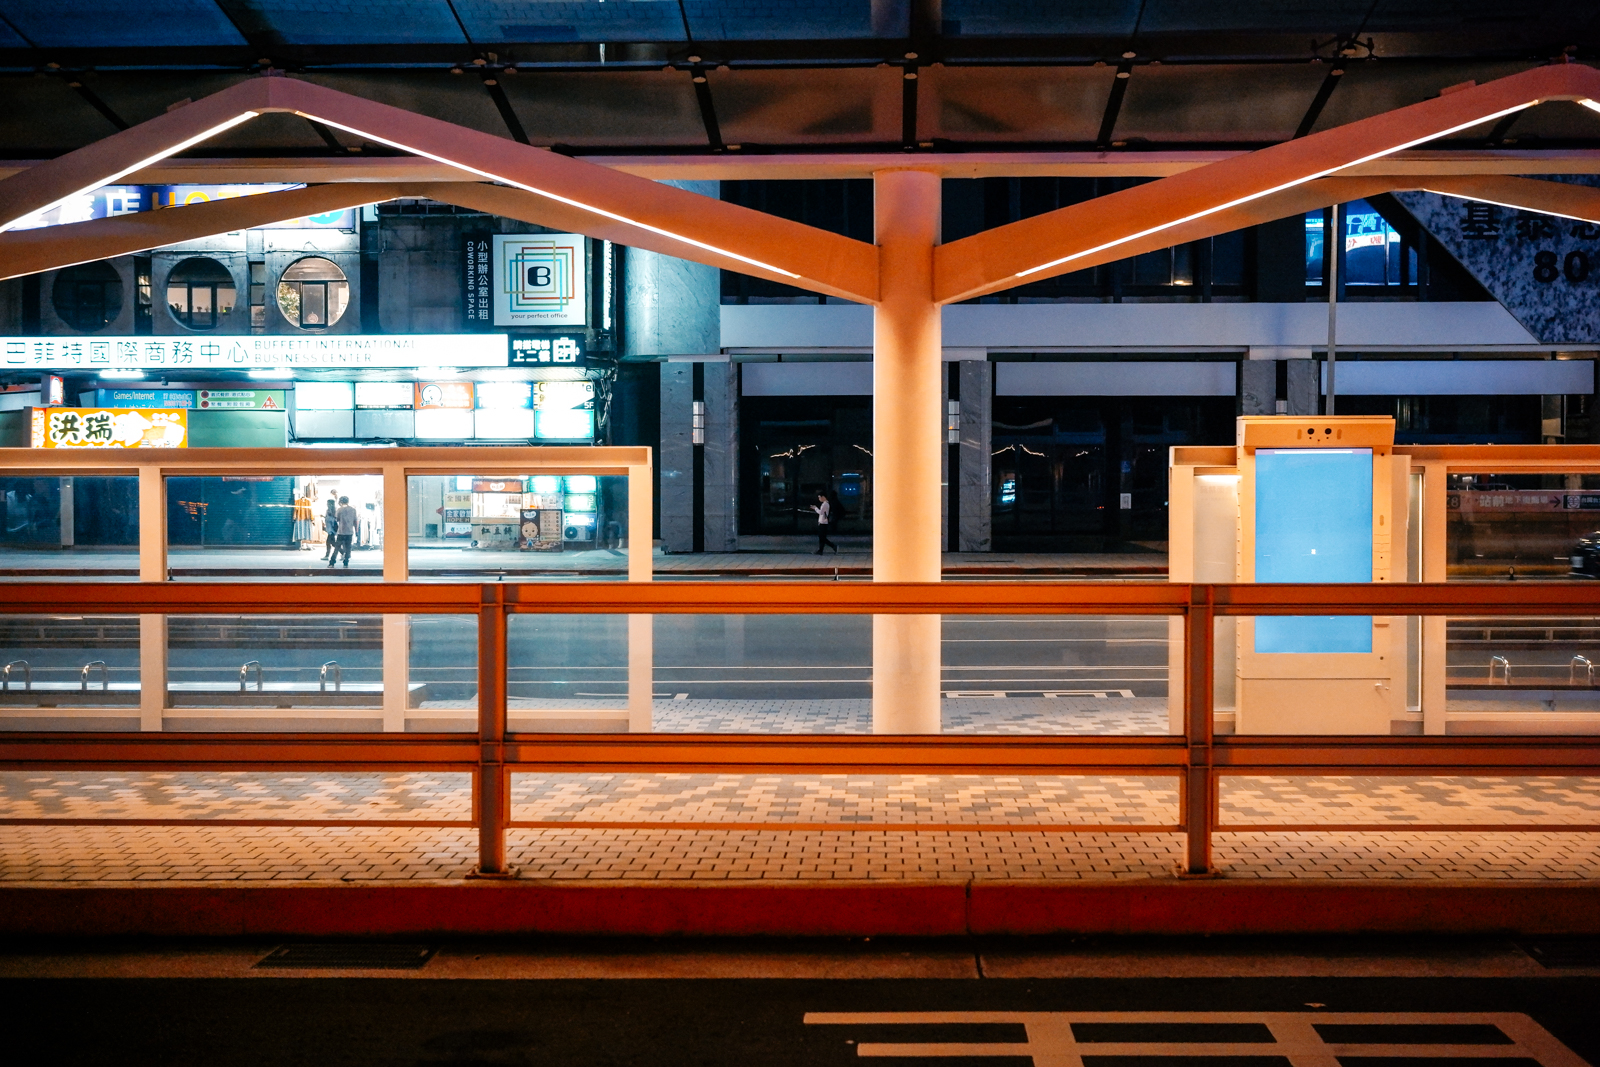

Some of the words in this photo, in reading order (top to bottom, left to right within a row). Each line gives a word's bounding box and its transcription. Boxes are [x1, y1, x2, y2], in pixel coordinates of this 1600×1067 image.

[467, 241, 475, 290] COWORKING
[1533, 250, 1589, 282] 80
[477, 240, 489, 320] 小型辦公室出租
[467, 293, 475, 319] SPACE
[6, 341, 249, 364] 巴菲特國際商務中心
[254, 340, 311, 350] BUFFETT
[315, 339, 415, 349] INTERNATIONAL
[254, 353, 318, 363] BUSINESS
[321, 353, 372, 363] CENTER
[113, 391, 155, 400] Games/Internet
